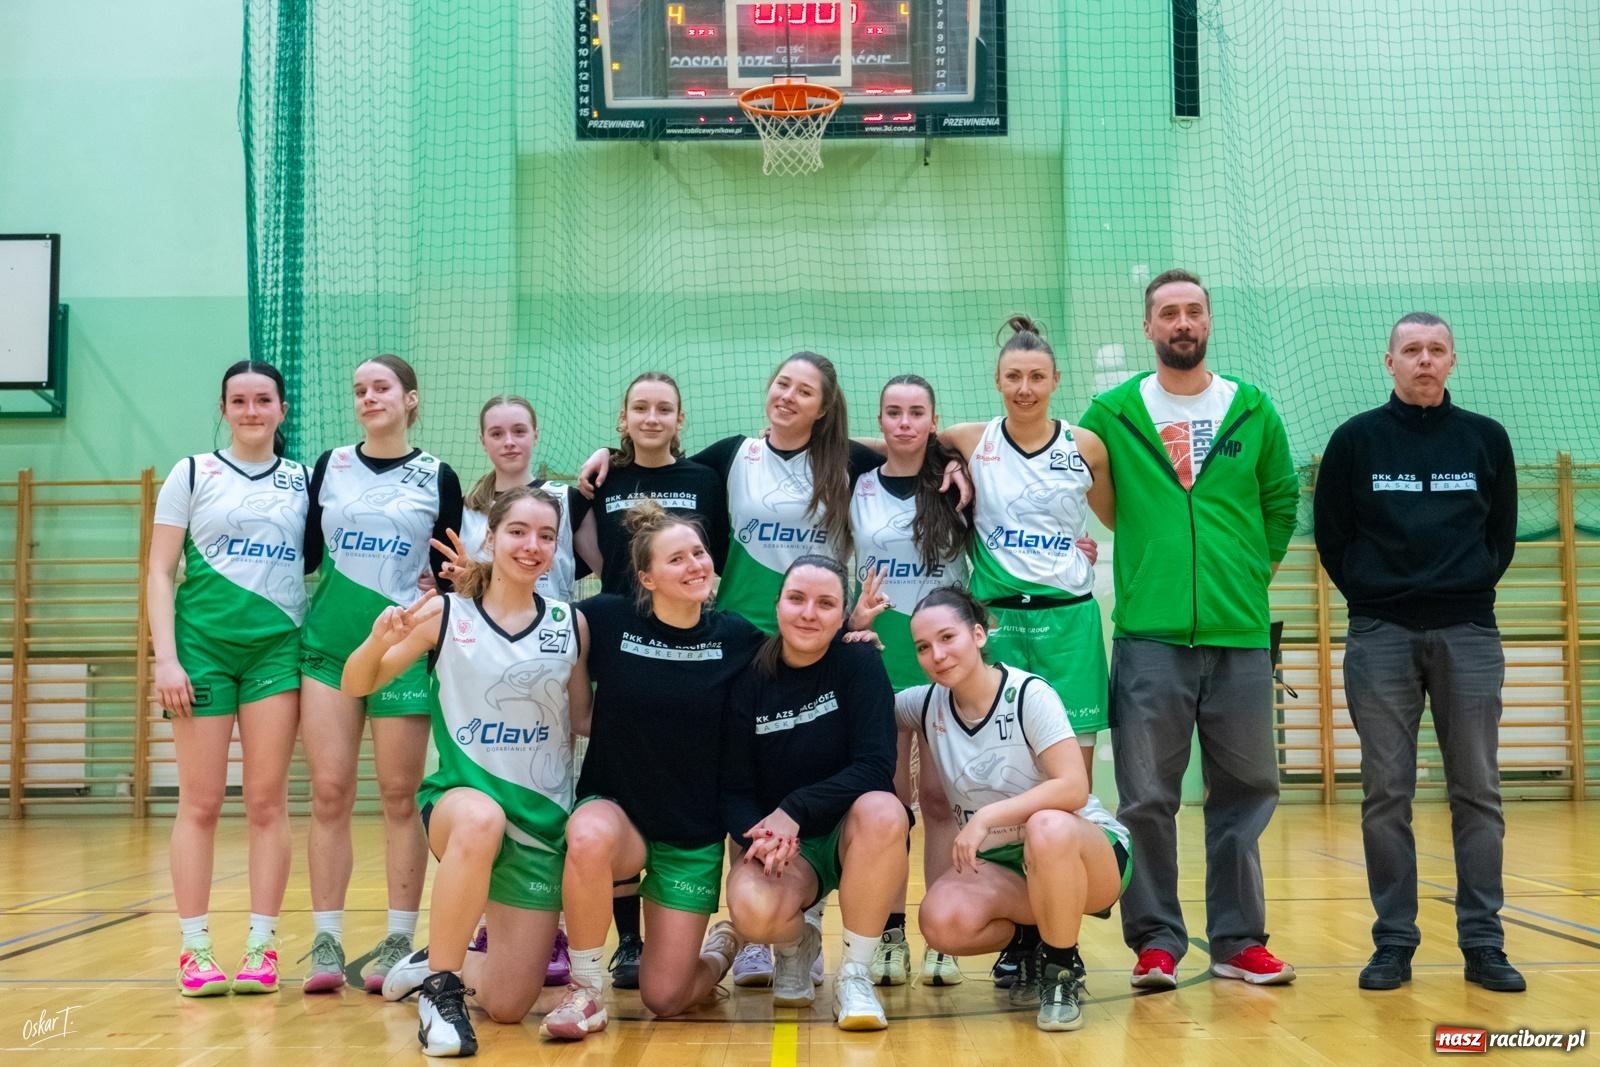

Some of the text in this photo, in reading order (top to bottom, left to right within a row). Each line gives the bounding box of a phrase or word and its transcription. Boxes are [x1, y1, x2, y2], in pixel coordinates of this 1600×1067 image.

[579, 12, 587, 20] 7
[937, 9, 944, 18] 7
[579, 24, 587, 32] 8
[937, 21, 944, 30] 8
[580, 36, 588, 44] 9
[937, 34, 944, 42] 9
[578, 48, 589, 57] 10
[935, 45, 946, 54] 10
[579, 60, 588, 68] 11
[935, 57, 945, 66] 11
[578, 72, 589, 80] 12
[935, 69, 946, 78] 12
[579, 84, 590, 92] 13
[579, 96, 590, 104] 14
[579, 108, 590, 117] 15
[587, 119, 645, 129] PRZEWINIENIA
[943, 117, 1000, 127] PRZEWINIENIA
[400, 463, 437, 488] 77
[1397, 473, 1417, 481] AZS
[605, 491, 698, 503] RKK AZS RACIBÓRZ
[758, 522, 829, 544] Clavis
[341, 531, 412, 557] Clavis
[1004, 530, 1072, 551] Clavis
[226, 538, 296, 562] Clavis
[539, 629, 571, 654] 27
[622, 631, 642, 644] RKK
[621, 641, 722, 660] BASKETBALL
[775, 710, 794, 719] AZS
[480, 720, 550, 744] Clavis
